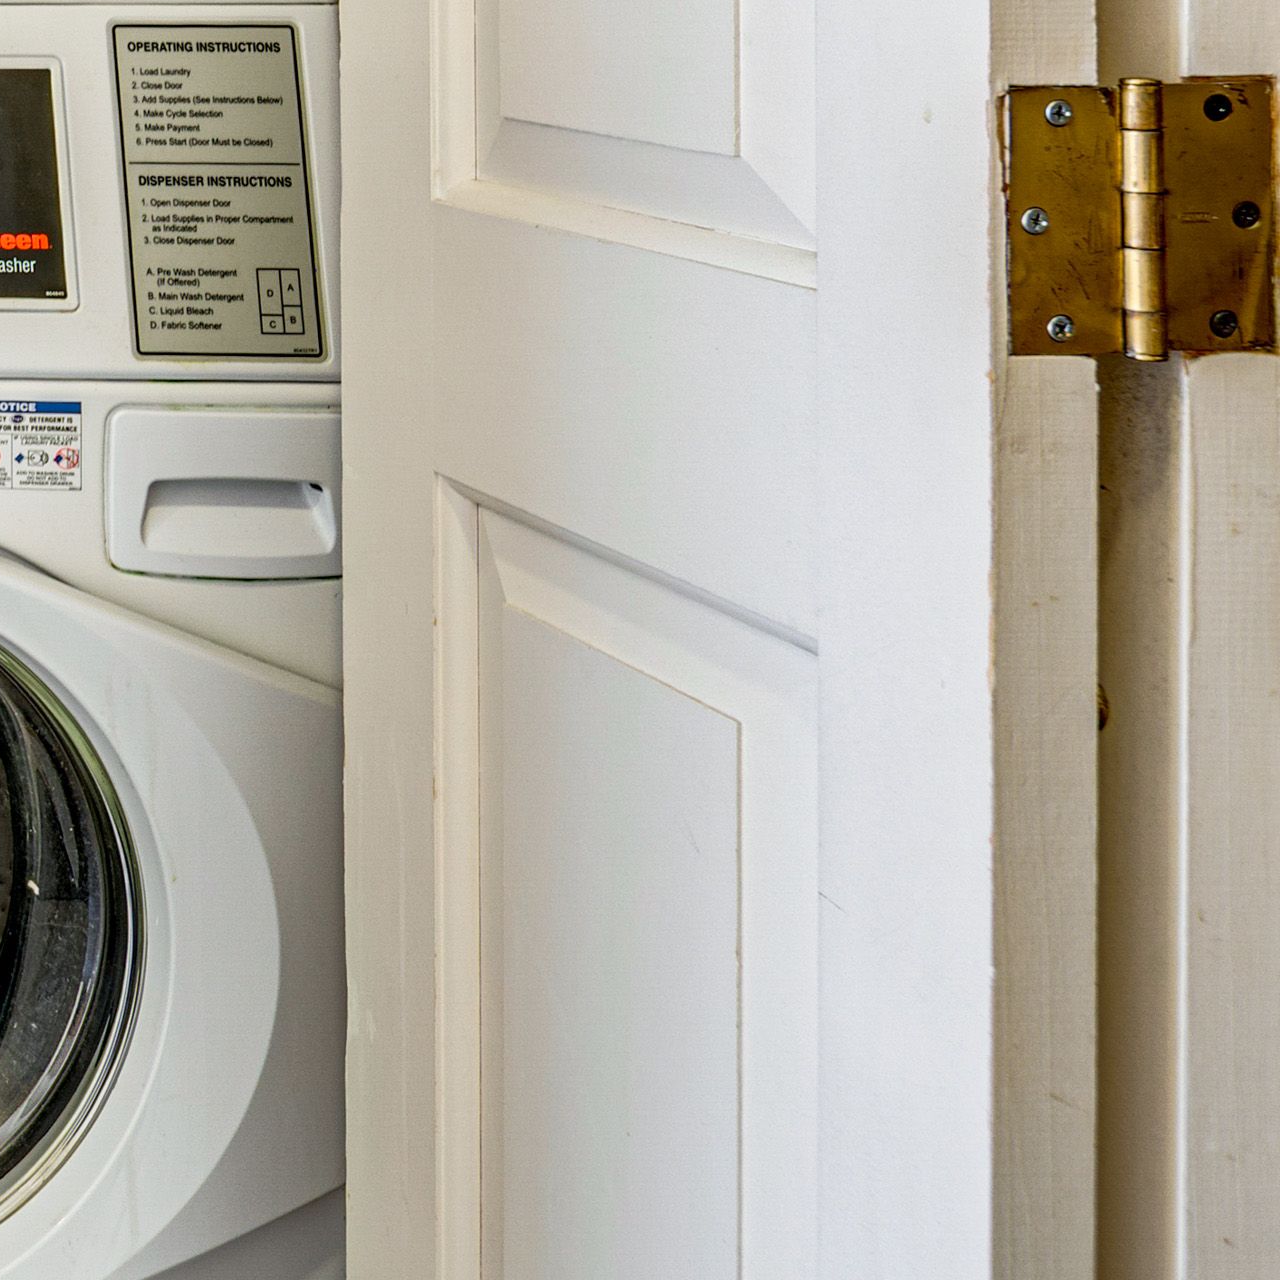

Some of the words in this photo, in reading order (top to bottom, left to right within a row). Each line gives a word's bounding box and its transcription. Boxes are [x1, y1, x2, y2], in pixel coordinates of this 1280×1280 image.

[127, 42, 192, 52] OPERATING
[197, 42, 280, 52] INSTRUCTIONS
[161, 68, 191, 77] Laundry
[257, 97, 283, 105] Below)
[166, 110, 186, 119] Cycle
[167, 124, 200, 132] Payment
[244, 139, 273, 147] Closed)
[139, 176, 203, 186] DISPENSER
[208, 176, 292, 187] INSTRUCTIONS
[150, 199, 171, 207] Open
[173, 199, 210, 207] Dispenser
[172, 215, 204, 223] Supplies
[216, 216, 240, 224] Proper
[243, 216, 293, 224] Compartment
[177, 237, 214, 245] Dispenser
[198, 269, 237, 278] Detergent
[167, 279, 200, 287] Offered)
[205, 294, 244, 302] Detergent
[161, 308, 184, 316] Liquid
[188, 322, 222, 330] Softener
